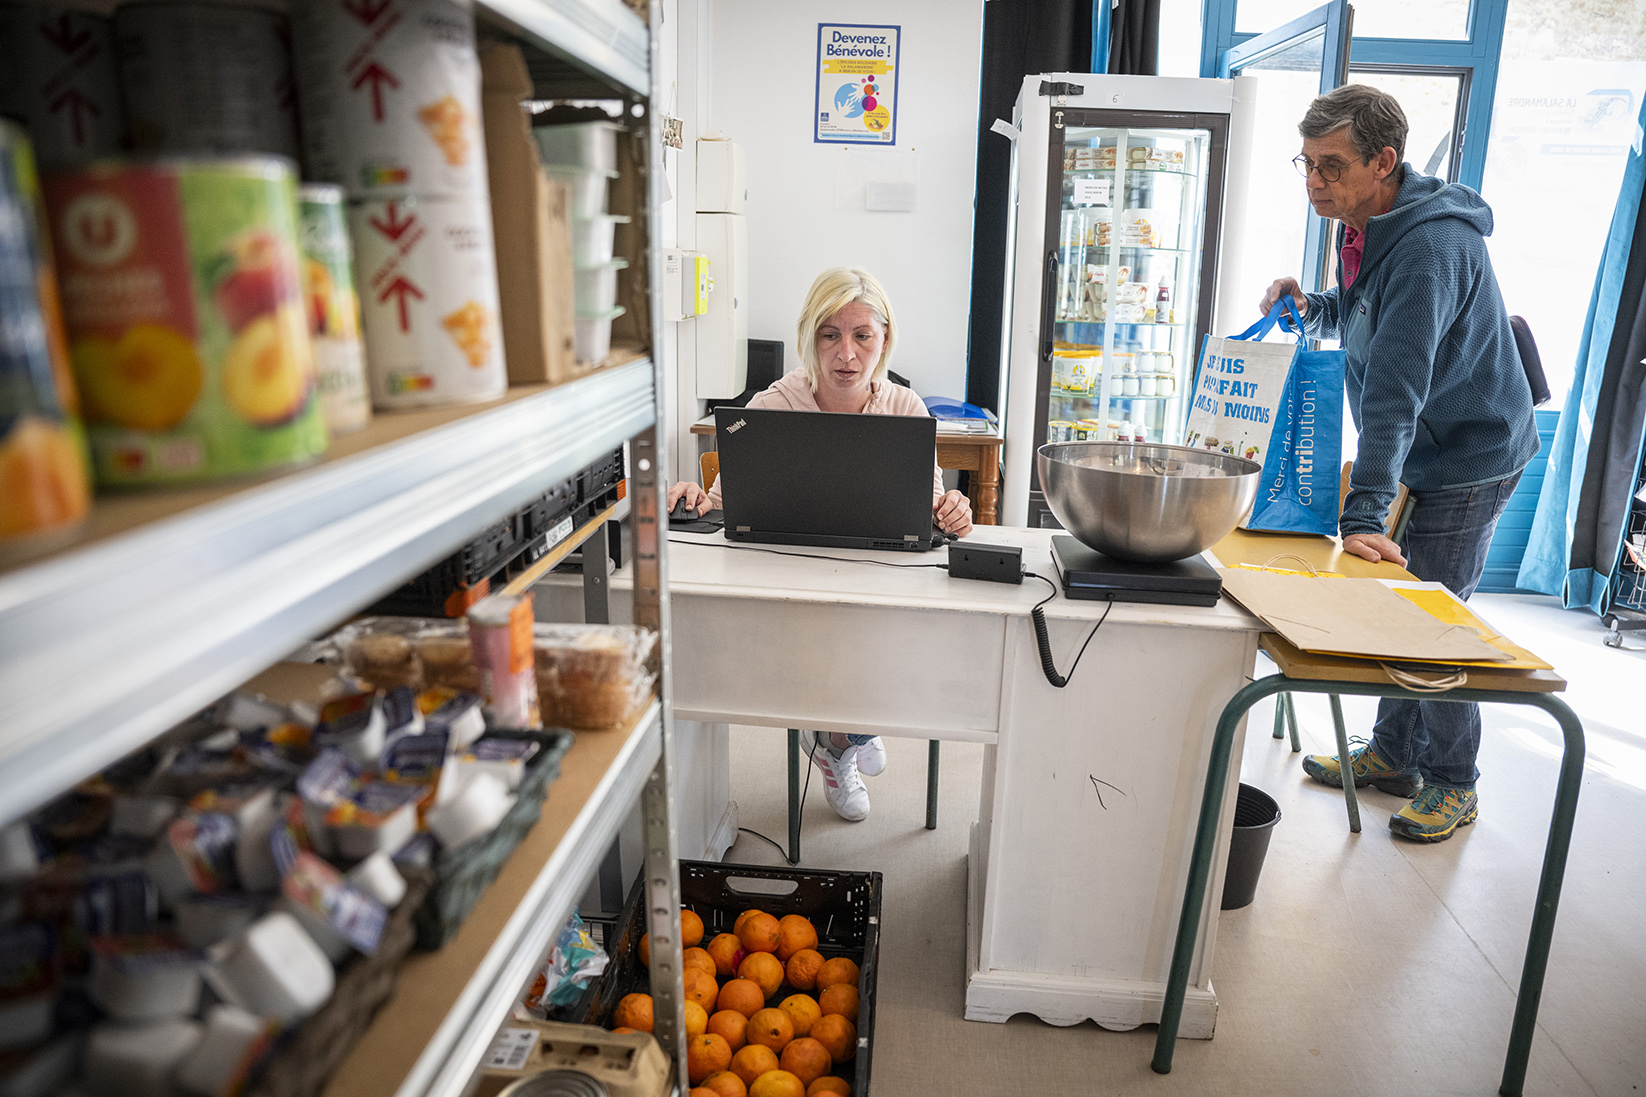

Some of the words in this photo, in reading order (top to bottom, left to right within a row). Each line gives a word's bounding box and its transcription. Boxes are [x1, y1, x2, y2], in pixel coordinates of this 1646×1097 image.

[832, 30, 887, 45] Devenez
[826, 43, 885, 58] Bénévole
[886, 44, 891, 58] !
[1112, 93, 1119, 103] 6
[1223, 401, 1271, 424] MOINS
[1294, 389, 1316, 506] contribution
[1267, 457, 1289, 503] Merci
[1282, 430, 1292, 453] de
